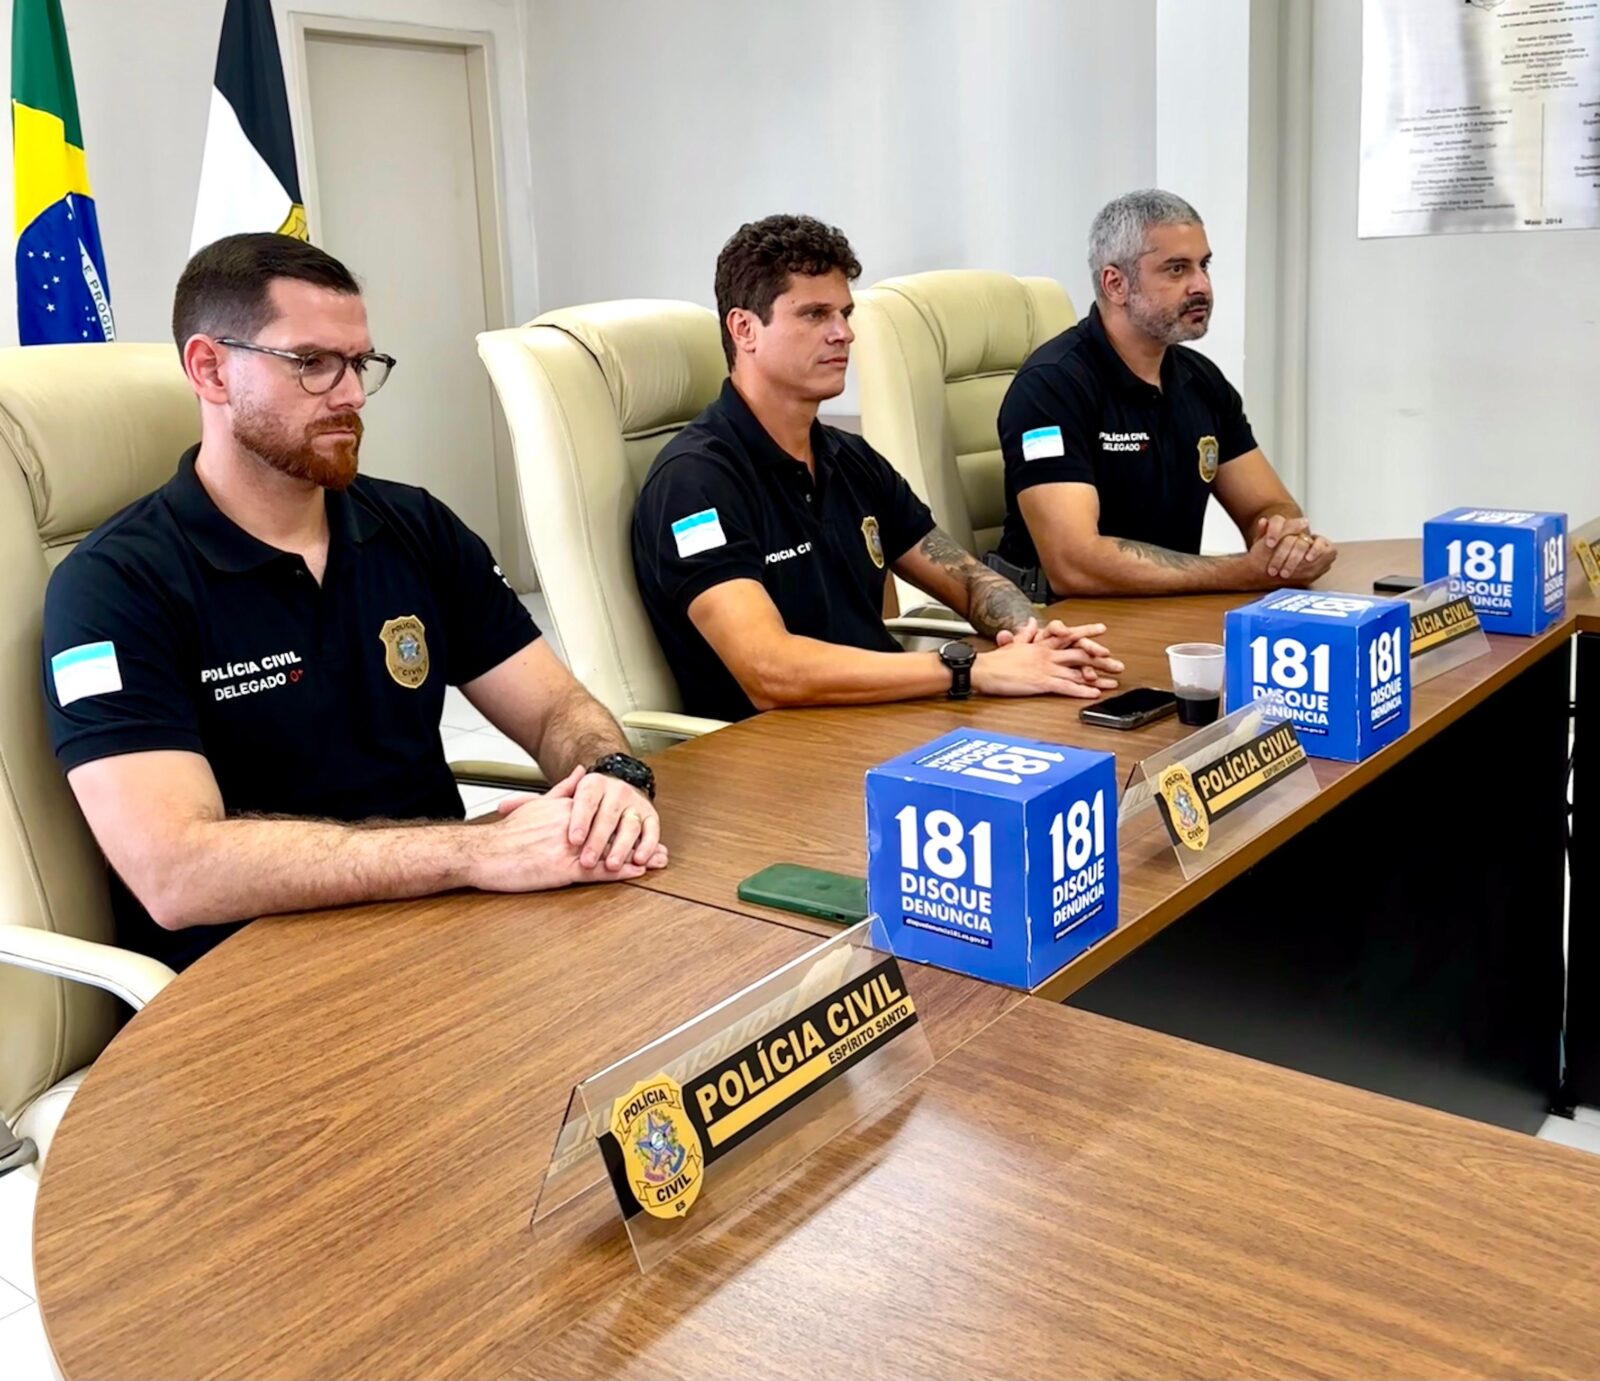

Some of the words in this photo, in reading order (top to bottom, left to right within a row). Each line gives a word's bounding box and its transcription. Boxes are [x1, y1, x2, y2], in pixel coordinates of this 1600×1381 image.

[1446, 539, 1514, 582] 181
[1543, 534, 1564, 580] 181
[1449, 580, 1513, 598] DISQUE
[1442, 601, 1474, 625] CIVIL
[201, 660, 261, 683] POLÍCIA
[261, 651, 302, 671] CIVIL
[1249, 636, 1329, 693] 181
[1369, 626, 1401, 689] 181
[214, 672, 287, 701] DELEGADO
[1253, 685, 1329, 712] DISQUE
[960, 745, 1066, 785] 181
[1199, 749, 1261, 799] POLÍCIA
[1259, 728, 1297, 759] CIVIL
[894, 805, 992, 889] 181
[1049, 789, 1105, 883] 181
[1187, 826, 1204, 840] CIVIL
[901, 872, 992, 914] DISQUE
[1053, 857, 1105, 908] DISQUE
[695, 1020, 826, 1124] POLÍCIA
[826, 973, 901, 1037] CIVIL
[828, 1025, 874, 1065] ESPÍRITO
[874, 1004, 908, 1034] SANTO
[623, 1088, 668, 1124] POLÍCIA
[656, 1173, 692, 1202] CIVIL
[675, 1200, 686, 1212] ES
